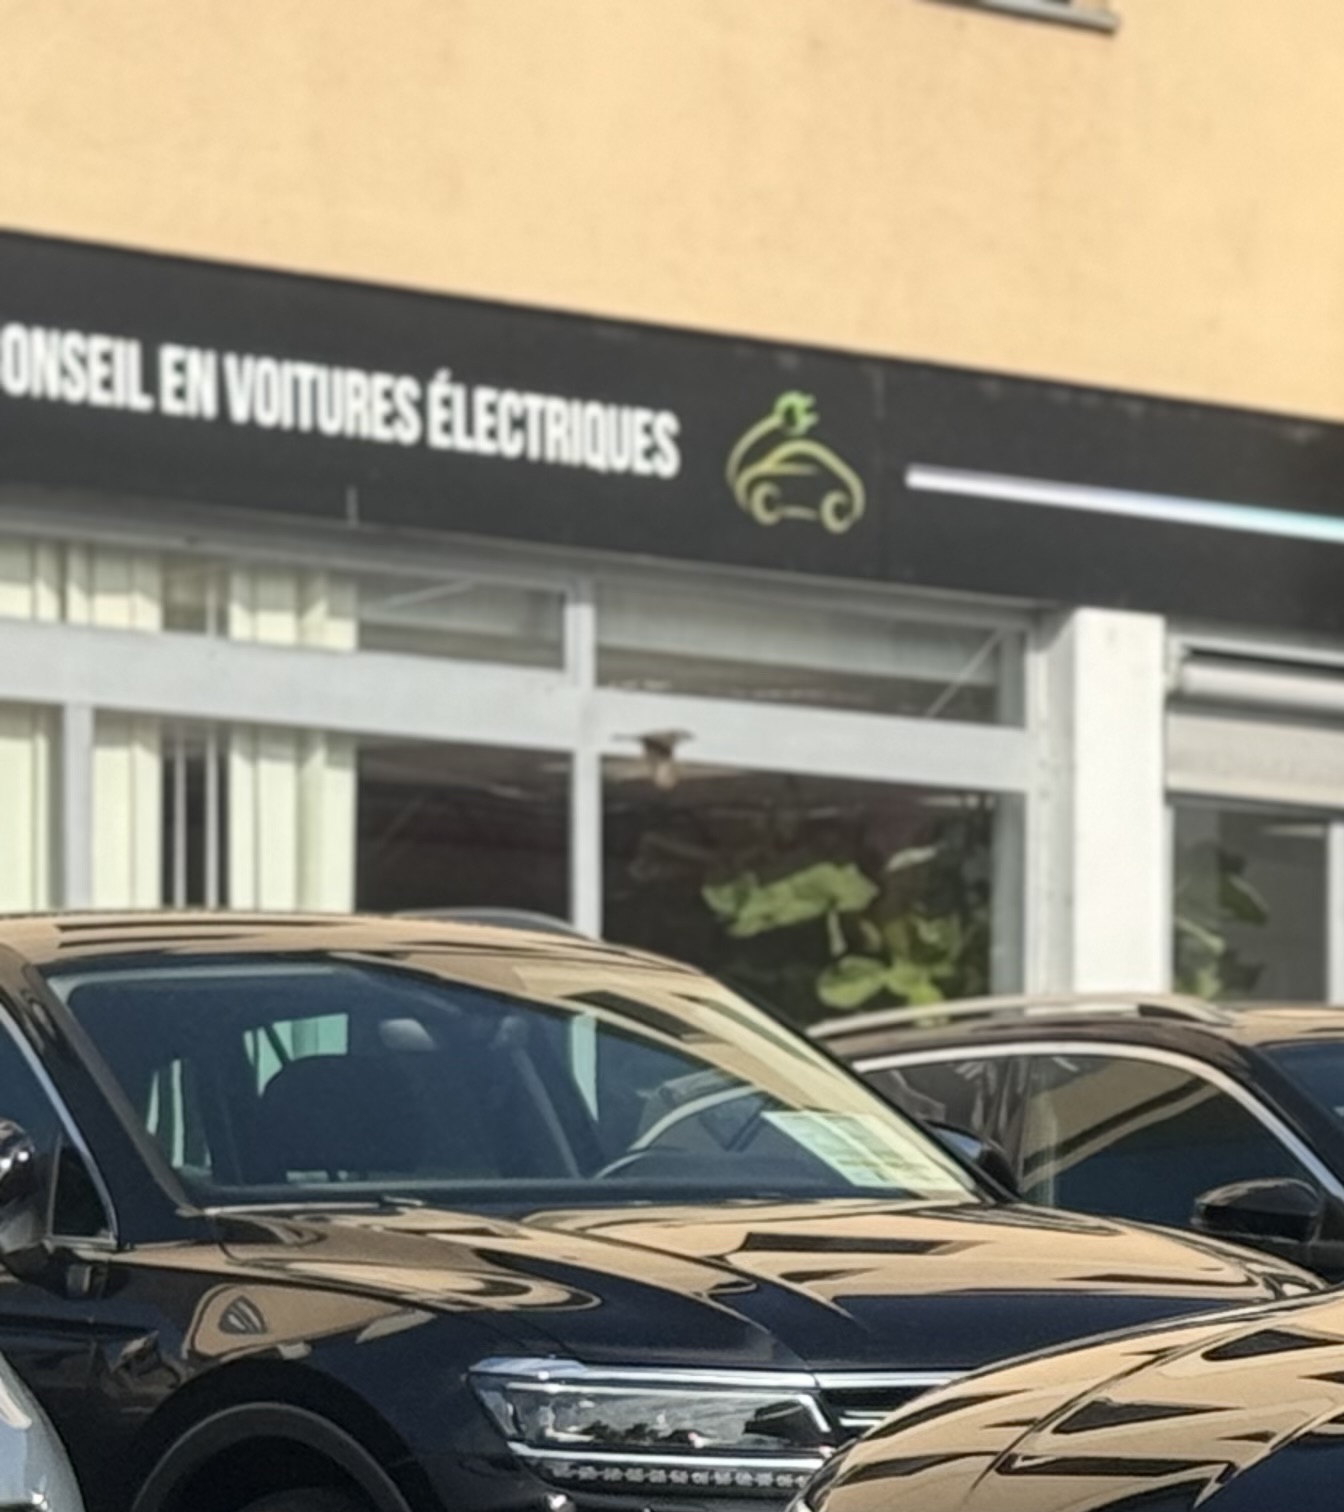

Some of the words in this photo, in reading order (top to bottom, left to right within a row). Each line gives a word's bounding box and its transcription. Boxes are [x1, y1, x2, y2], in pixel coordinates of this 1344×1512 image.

[159, 343, 218, 421] EN
[223, 351, 422, 445] VOITURES
[428, 367, 681, 478] ÉLECTRIQUES
